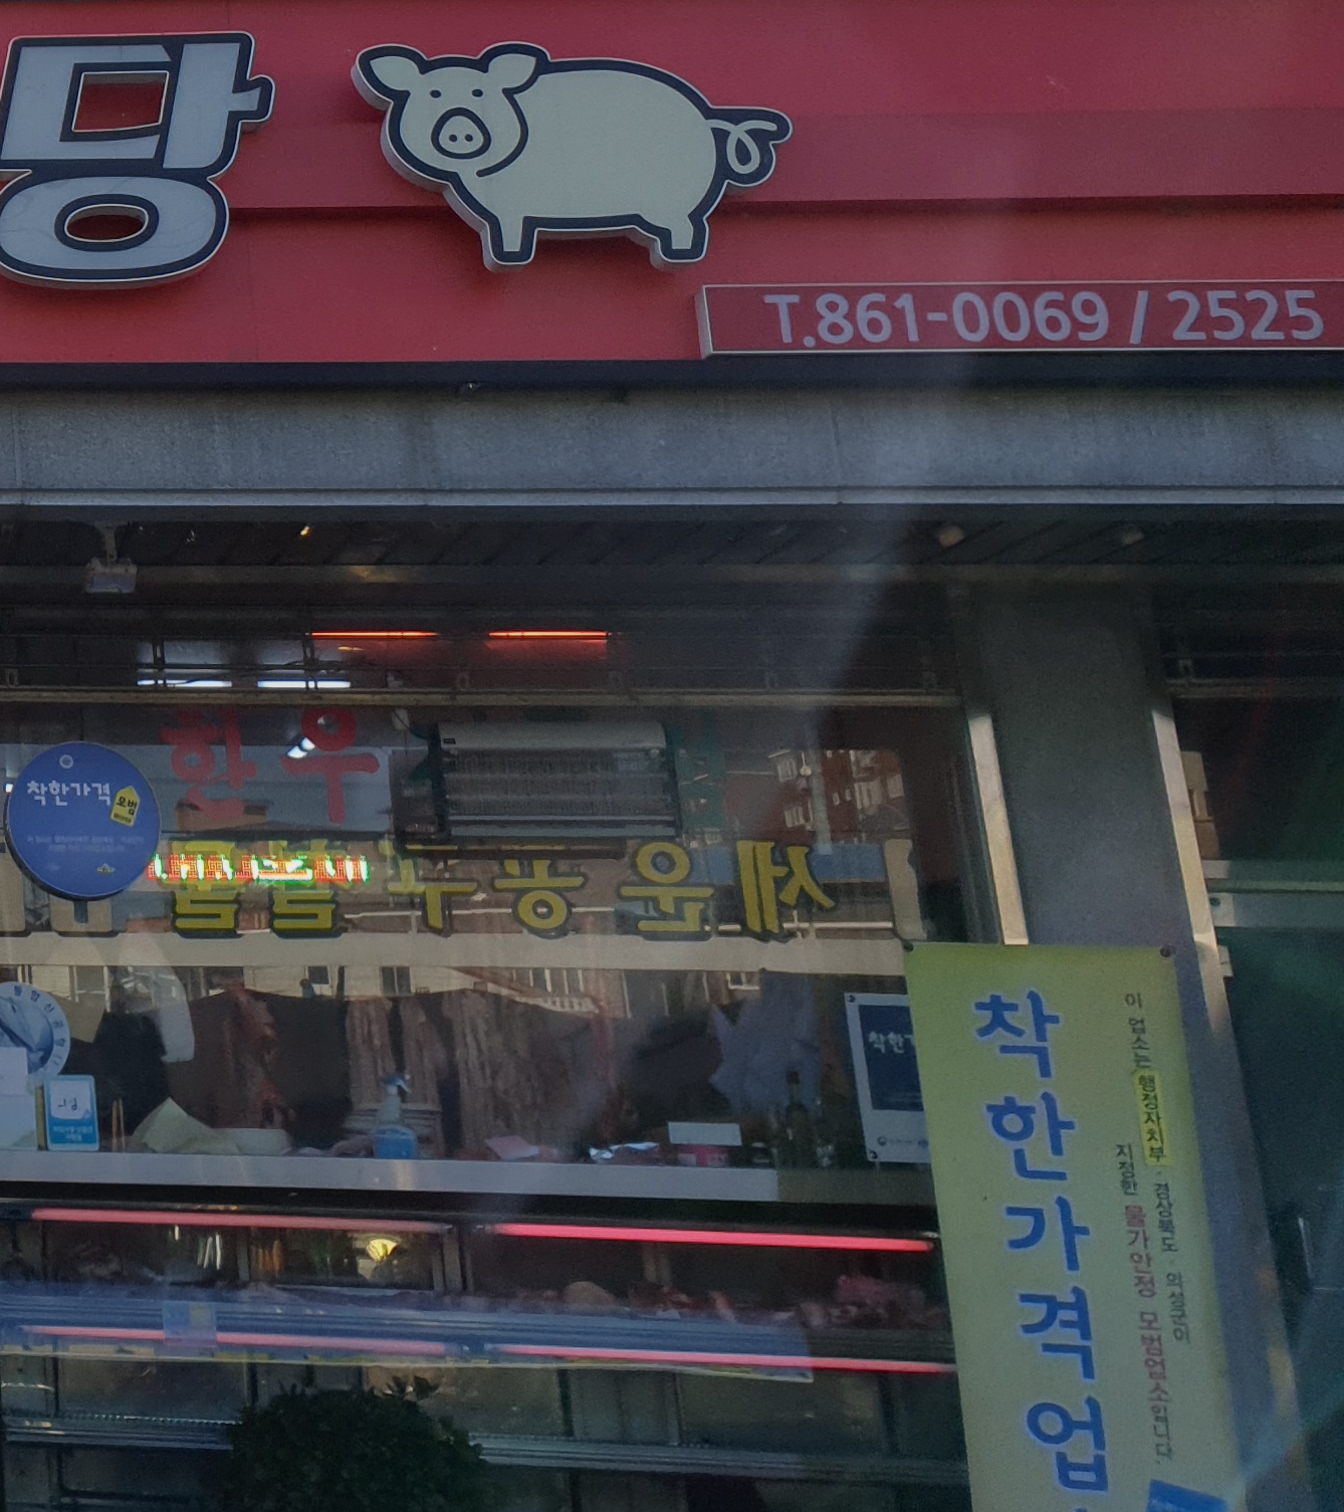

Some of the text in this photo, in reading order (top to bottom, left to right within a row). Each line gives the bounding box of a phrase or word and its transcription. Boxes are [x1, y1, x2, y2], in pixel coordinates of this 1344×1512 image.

[764, 290, 1109, 347] T.861-0069
[1168, 289, 1325, 342] 2525
[26, 780, 111, 806] 착한가격
[116, 796, 138, 816] 모범
[1123, 991, 1143, 1009] 이
[973, 988, 1110, 1512] 착한가격업
